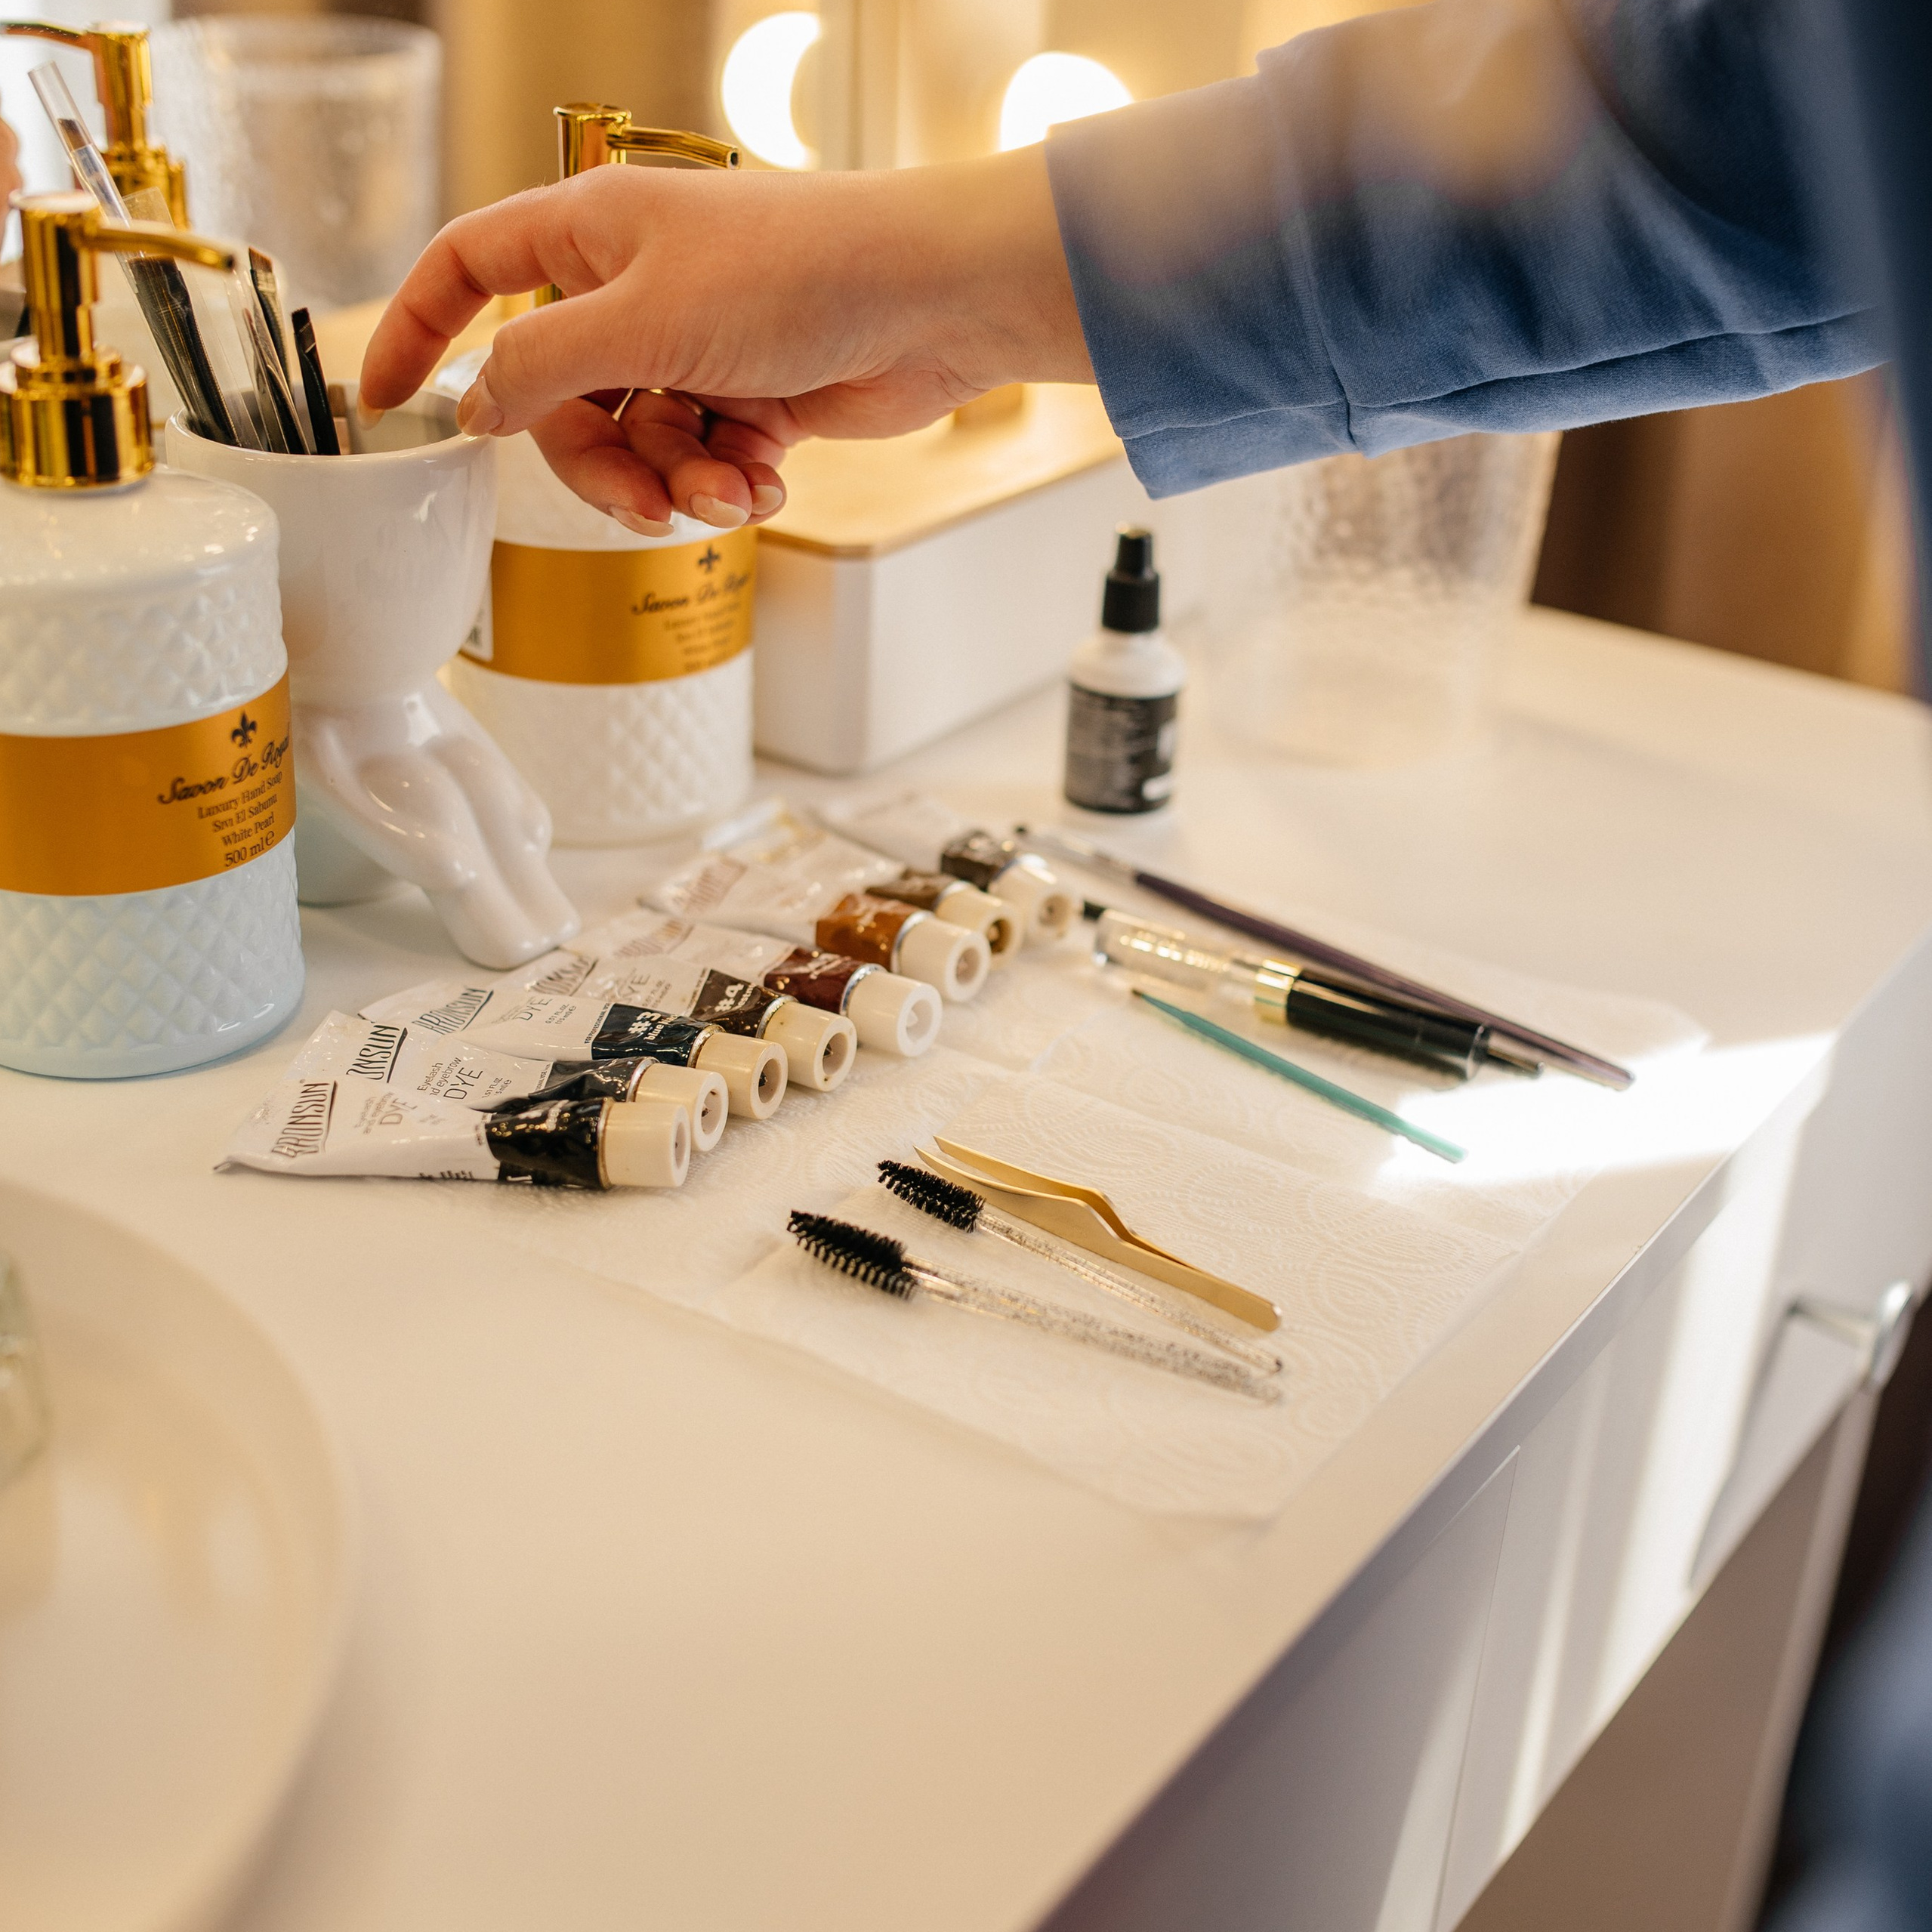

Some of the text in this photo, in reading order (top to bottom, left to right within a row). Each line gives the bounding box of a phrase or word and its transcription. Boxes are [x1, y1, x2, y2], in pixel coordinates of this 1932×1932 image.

[157, 775, 229, 804] Savon
[232, 754, 259, 784] De
[198, 771, 283, 819] Luxury Hand Soap
[236, 809, 247, 825] El
[248, 793, 278, 818] Sabunu
[222, 811, 275, 847] White Pearl
[225, 846, 248, 868] 500
[514, 998, 554, 1021] DYE
[714, 983, 745, 1013] #4
[628, 1011, 662, 1035] #3
[643, 1020, 665, 1042] blue
[345, 1024, 400, 1081] ONSUN
[416, 1062, 444, 1092] Eyelash
[436, 1057, 462, 1088] eyebrow
[443, 1067, 484, 1100] DYE
[270, 1082, 331, 1159] BRONSUN
[379, 1097, 418, 1125] DYE
